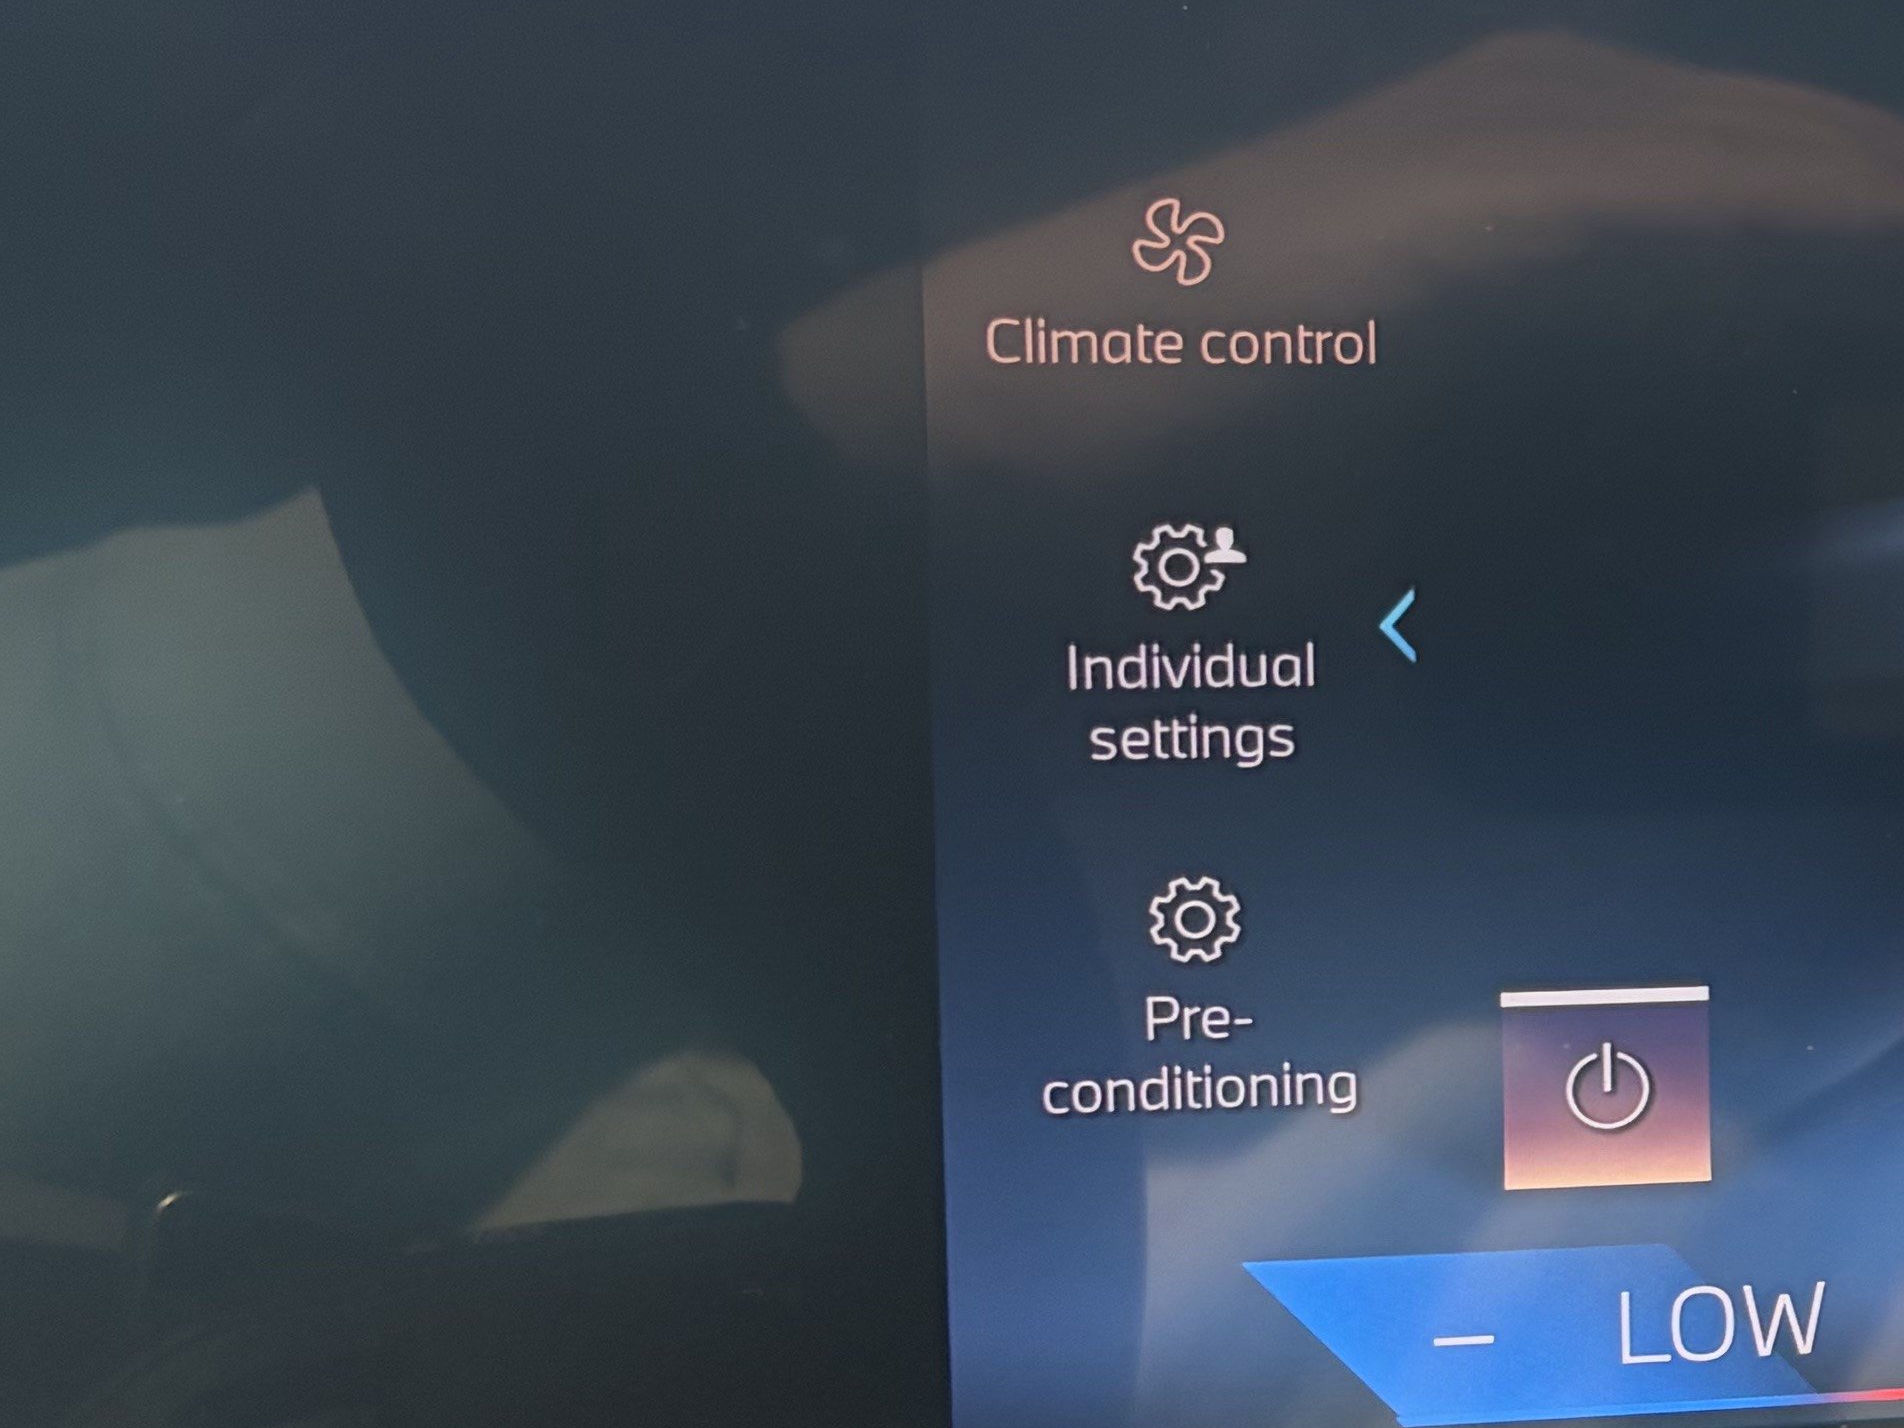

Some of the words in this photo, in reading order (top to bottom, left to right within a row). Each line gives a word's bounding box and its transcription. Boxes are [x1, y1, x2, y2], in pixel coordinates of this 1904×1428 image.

[985, 316, 1185, 366] Climate
[1199, 318, 1377, 366] control
[1067, 640, 1316, 691] Individual
[1089, 712, 1296, 769] settings
[1145, 994, 1254, 1042] Pre-
[1042, 1060, 1358, 1115] conditioning
[1619, 1279, 1828, 1367] LOW
